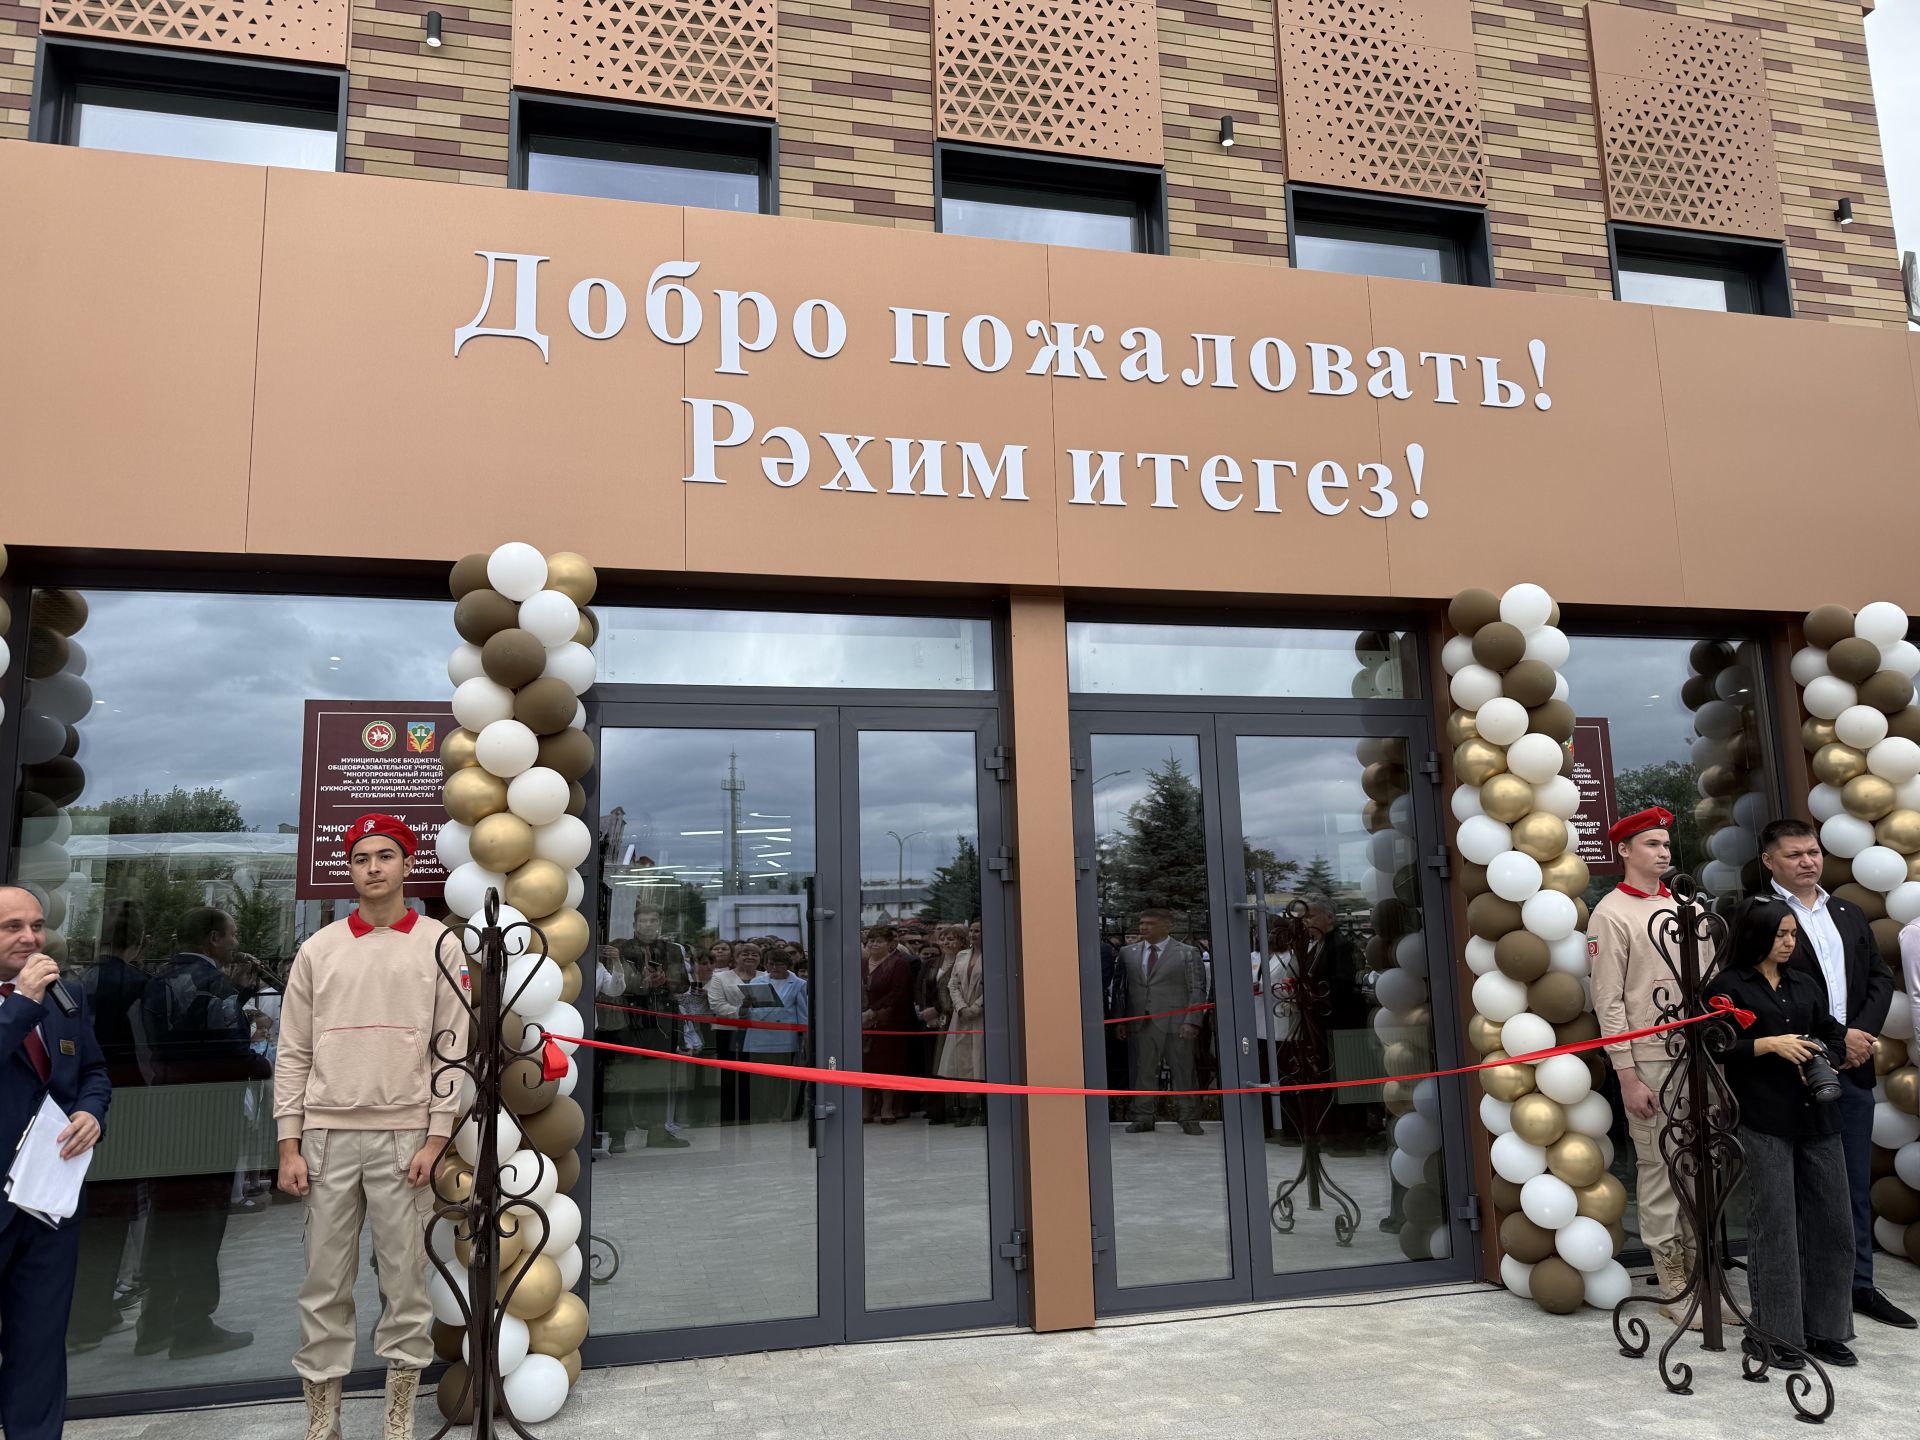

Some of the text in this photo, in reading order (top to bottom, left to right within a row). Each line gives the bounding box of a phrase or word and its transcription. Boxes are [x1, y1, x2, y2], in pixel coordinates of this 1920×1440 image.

[454, 250, 1552, 411] Добро пожаловать!
[681, 397, 1429, 519] Рәхим итегез!
[420, 770, 443, 778] ЛИЦЕЙ
